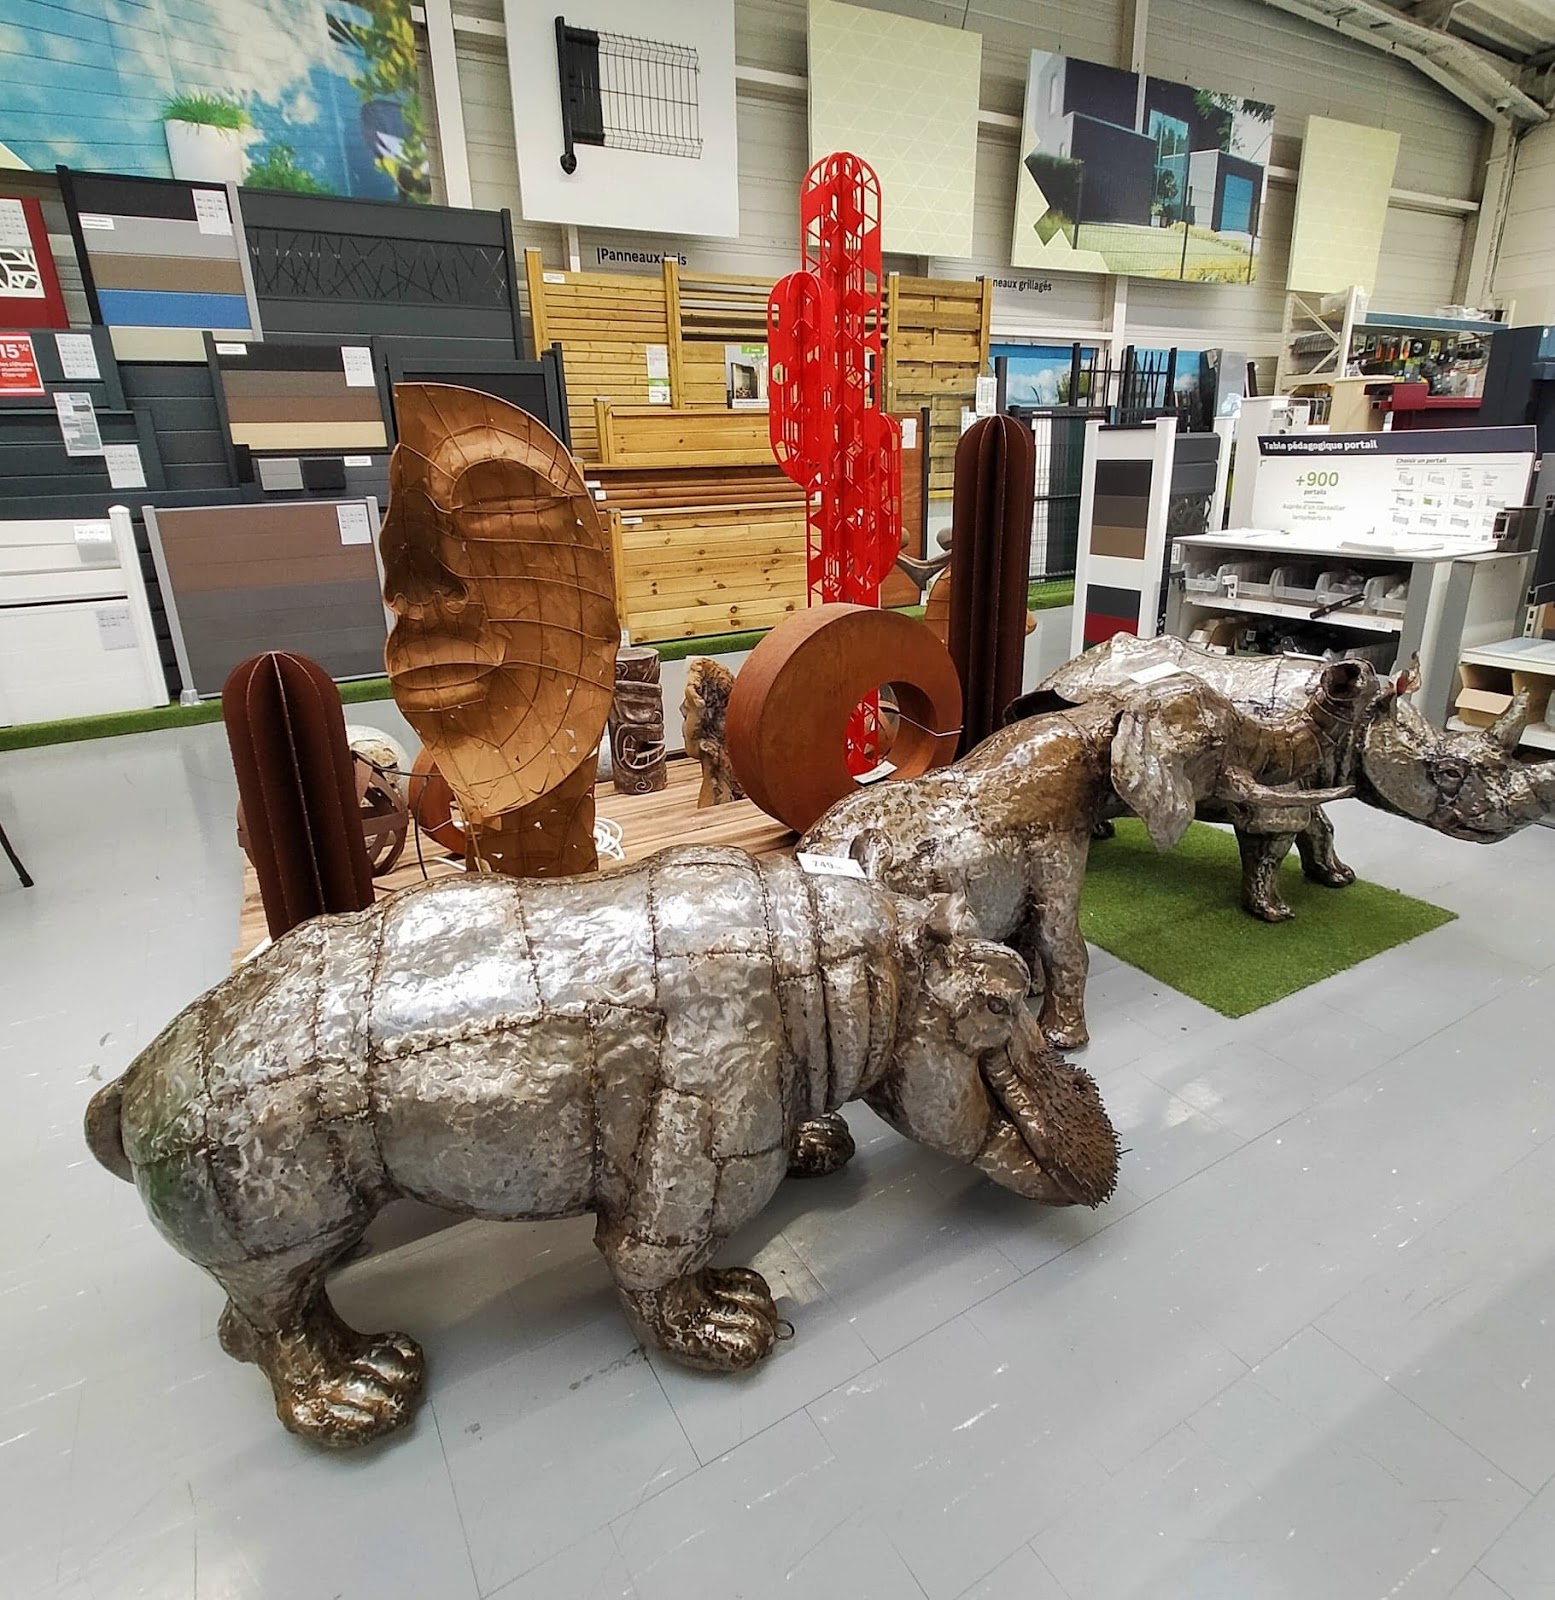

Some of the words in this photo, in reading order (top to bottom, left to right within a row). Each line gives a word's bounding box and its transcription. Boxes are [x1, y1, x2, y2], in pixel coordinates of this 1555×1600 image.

[600, 247, 661, 264] Panneaux
[1019, 279, 1053, 293] grillagés
[1263, 441, 1287, 451] Table
[1287, 440, 1344, 452] pédagogique
[1344, 439, 1378, 451] portail
[1425, 457, 1447, 465] portail
[1295, 471, 1339, 487] +900
